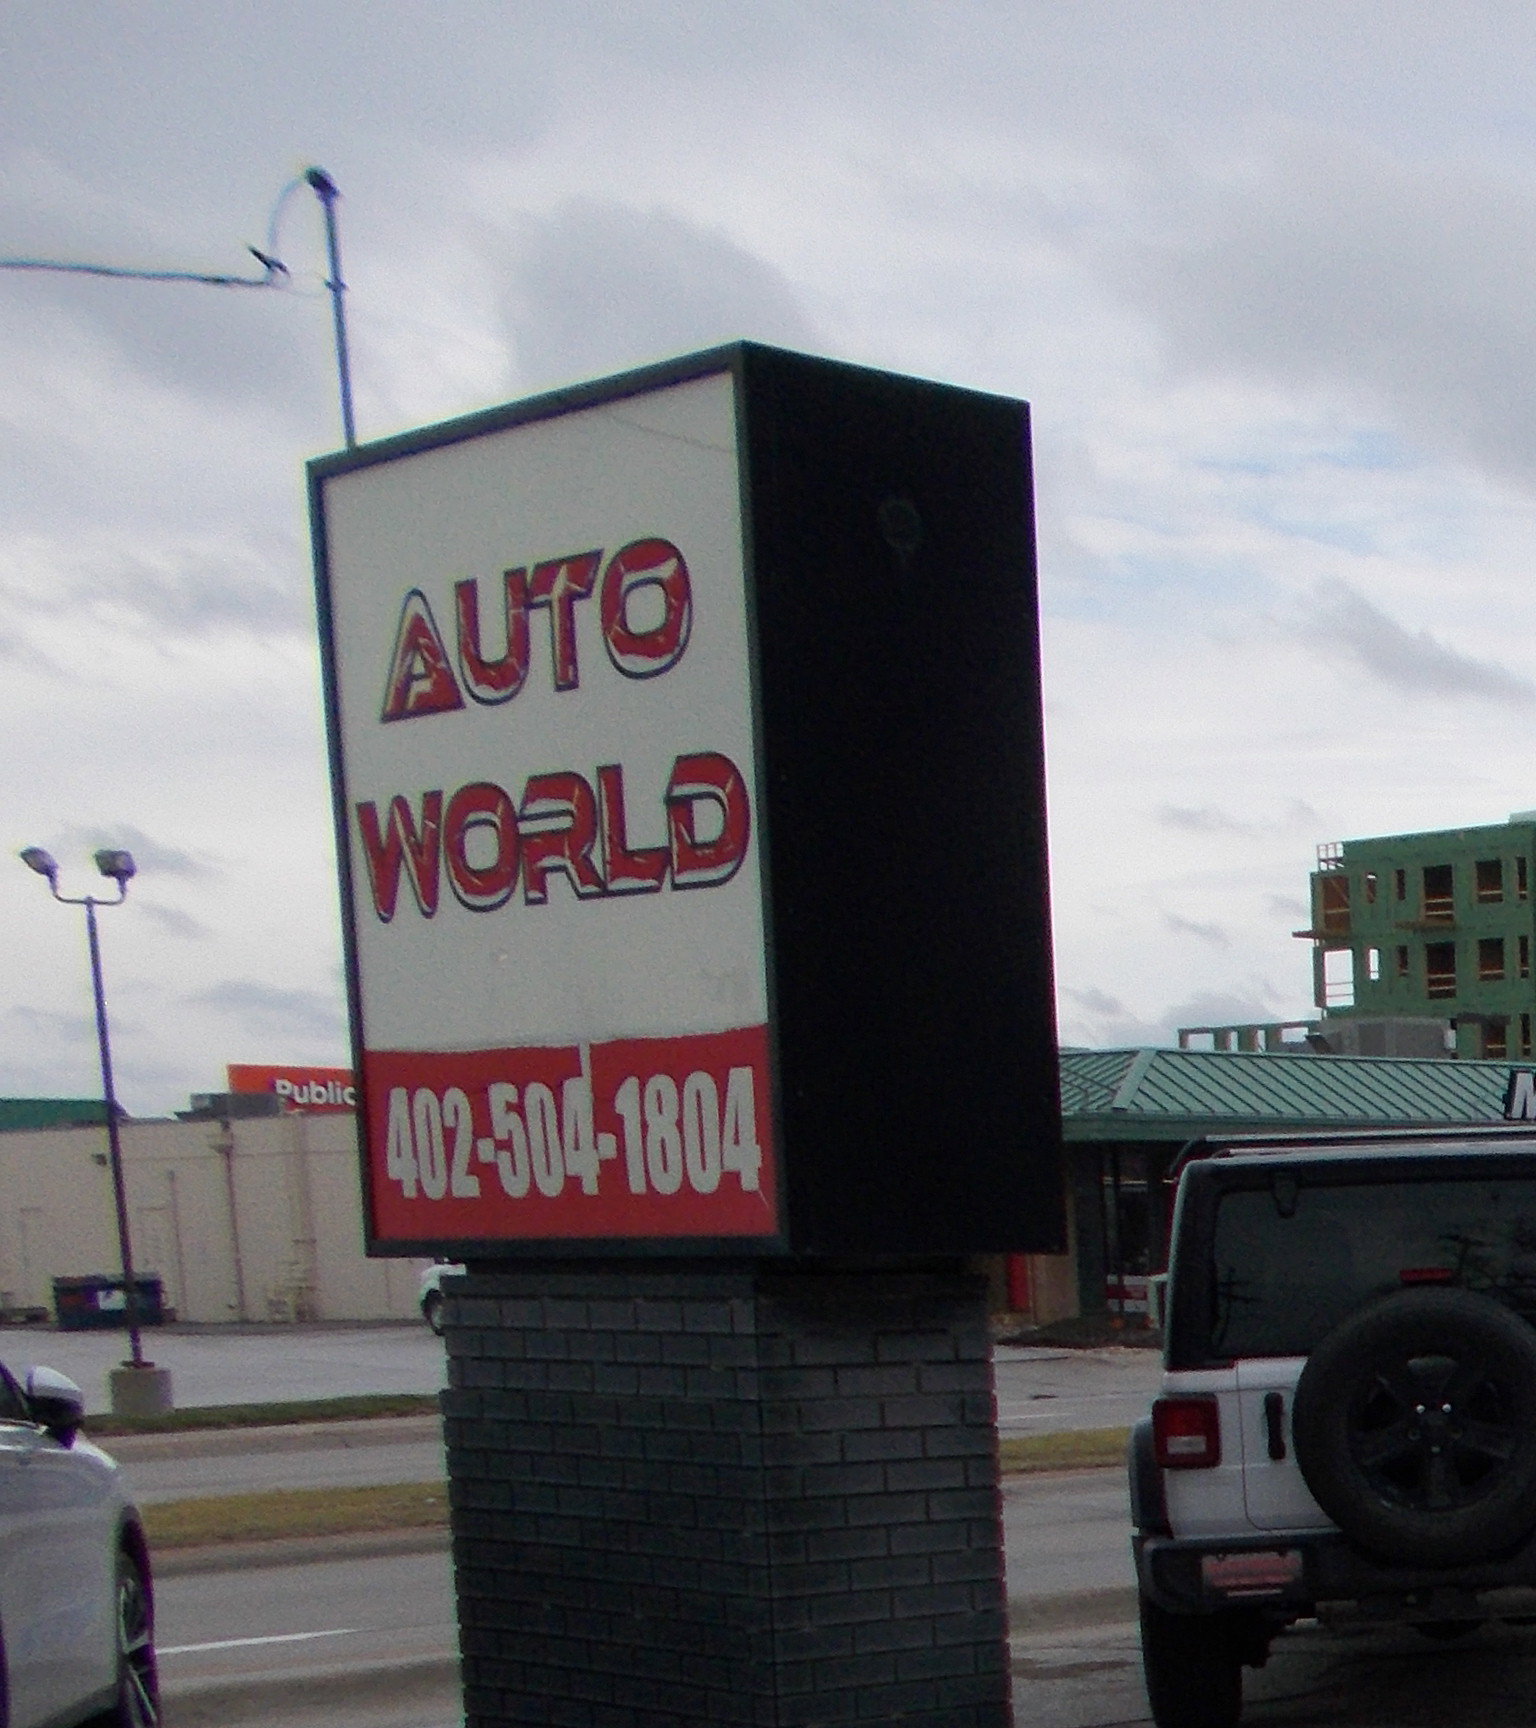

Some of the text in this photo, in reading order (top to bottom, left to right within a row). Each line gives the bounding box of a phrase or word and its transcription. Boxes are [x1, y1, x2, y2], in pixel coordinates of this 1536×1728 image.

[380, 537, 693, 724] AUTO
[355, 752, 752, 924] WORLD
[275, 1079, 357, 1106] Public
[386, 1065, 763, 1199] 402-504-1804
